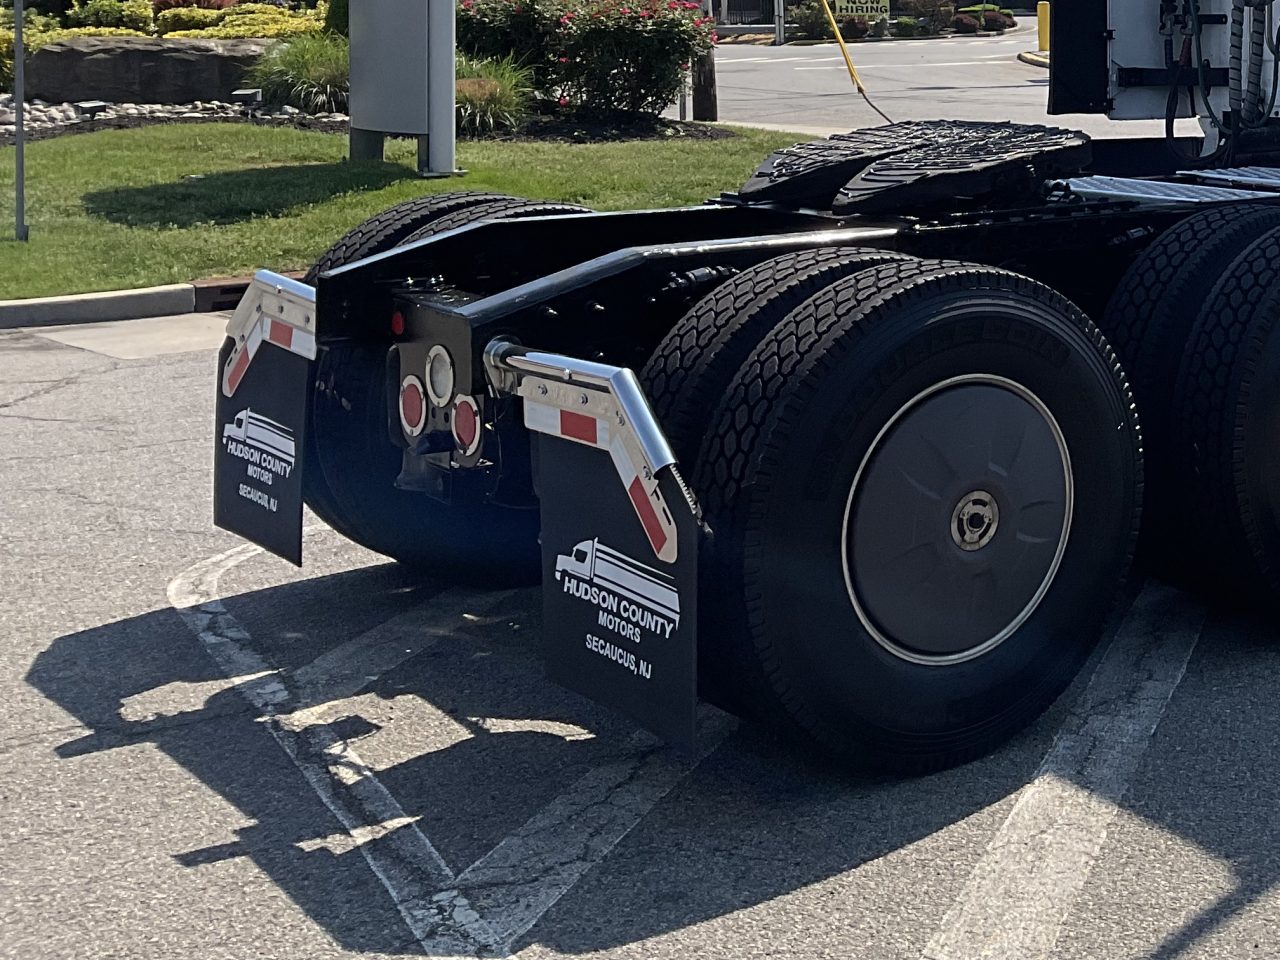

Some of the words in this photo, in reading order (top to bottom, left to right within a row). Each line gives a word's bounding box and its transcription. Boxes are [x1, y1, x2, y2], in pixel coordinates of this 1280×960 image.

[839, 5, 888, 14] HIRING
[227, 440, 261, 465] HUDSON
[261, 453, 292, 478] COUNTY
[247, 464, 273, 486] MOTORS
[269, 497, 278, 512] NJ
[563, 576, 618, 613] HUDSON
[620, 600, 674, 639] COUNTY
[598, 610, 641, 643] MOTORS
[585, 634, 638, 675] SECAUCUS,
[639, 659, 652, 679] NJ
